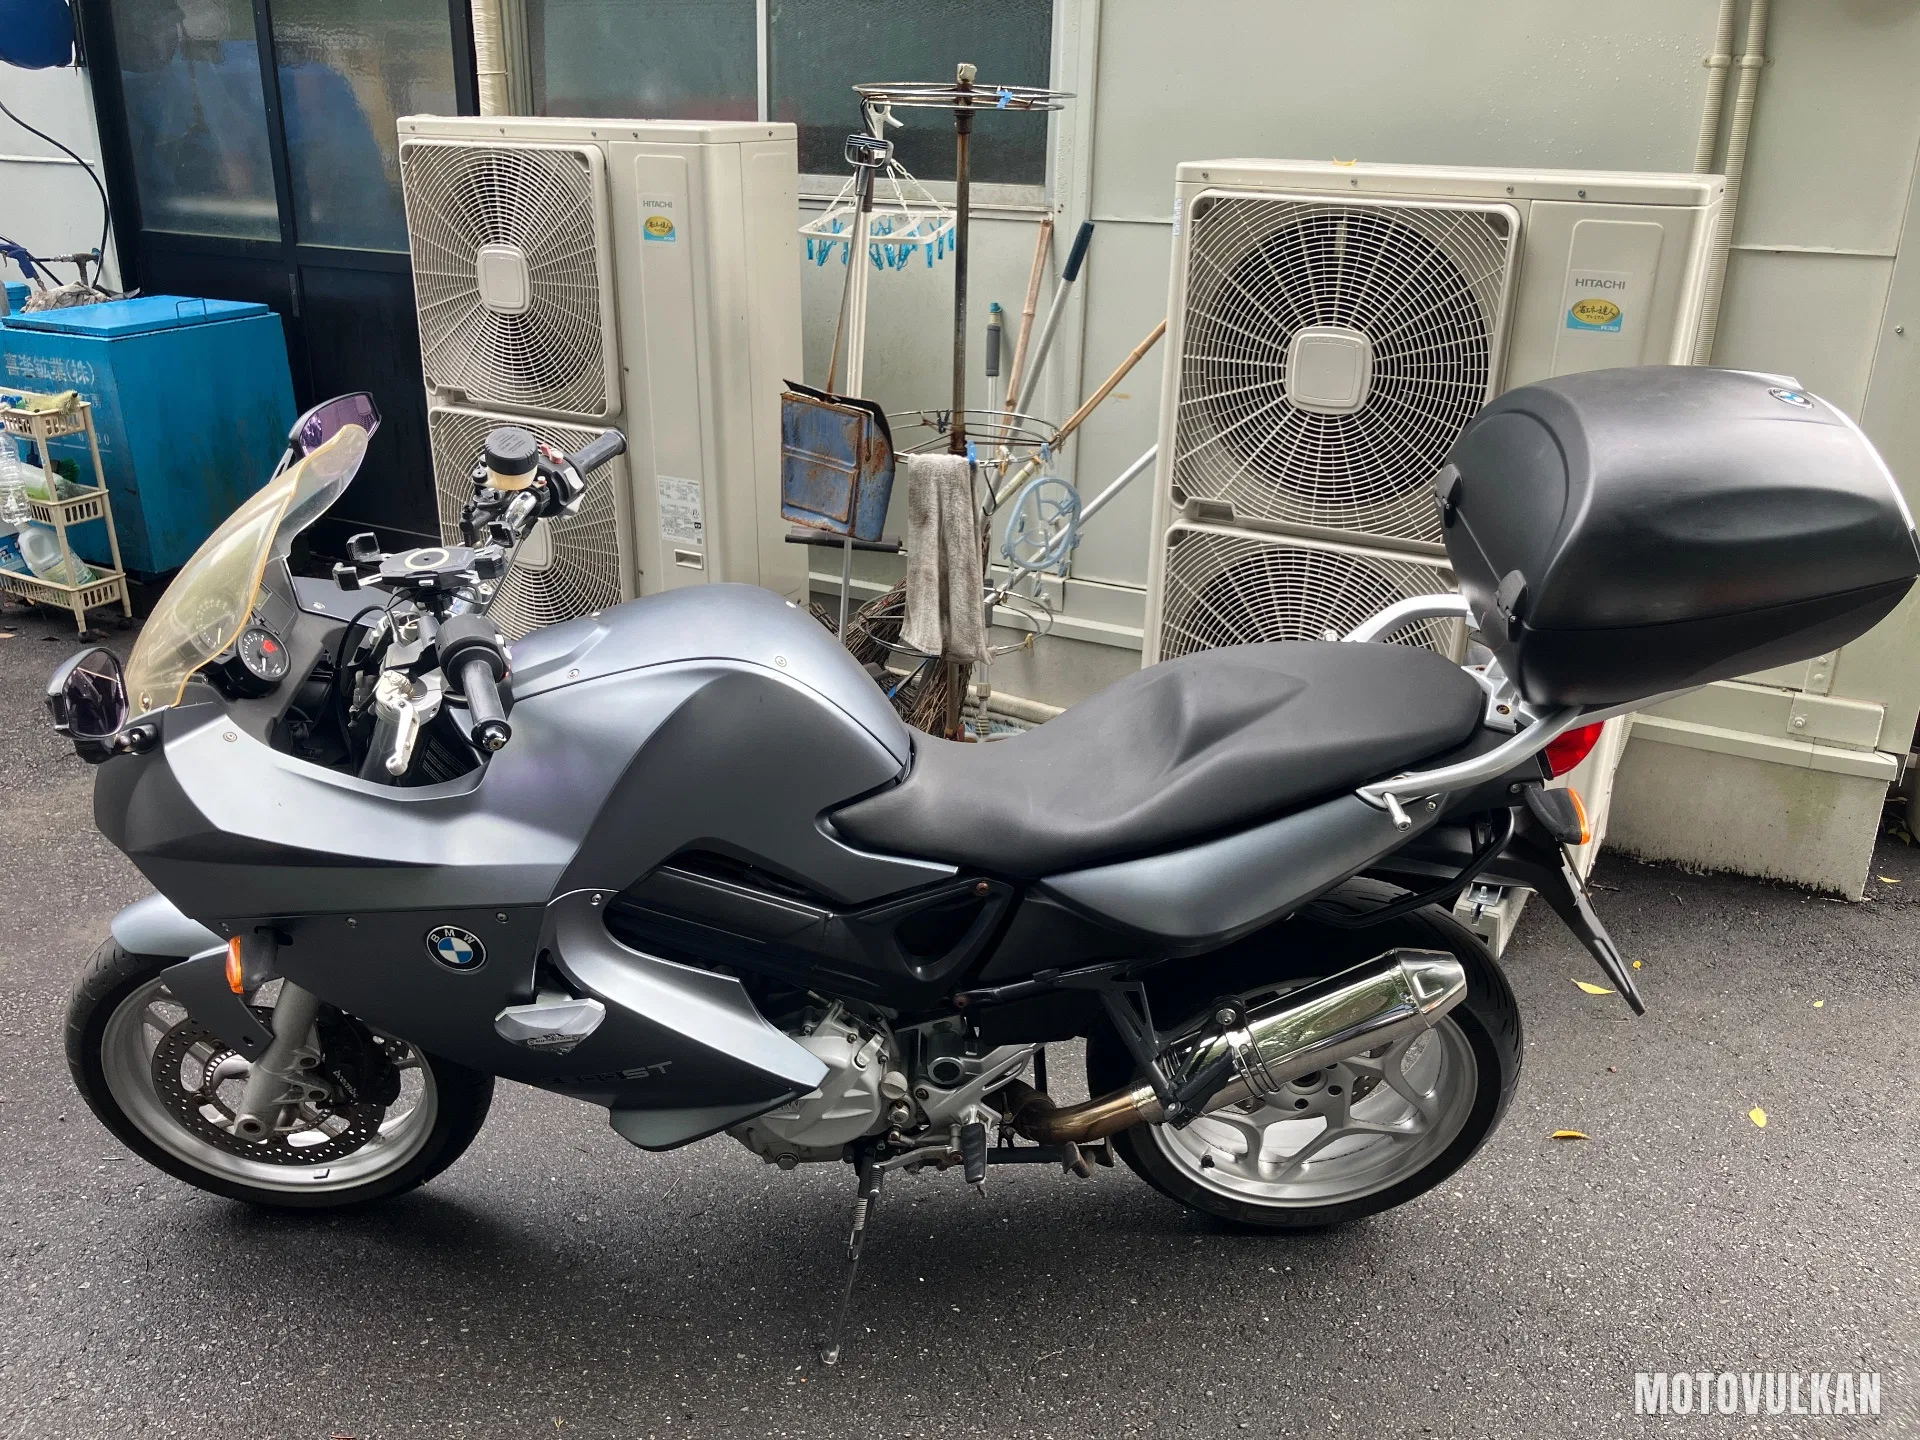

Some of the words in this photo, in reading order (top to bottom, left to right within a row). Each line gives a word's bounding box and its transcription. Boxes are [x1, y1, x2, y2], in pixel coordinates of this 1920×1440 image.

[643, 200, 673, 208] HITACHI
[1575, 278, 1626, 290] HITACHI
[430, 928, 476, 944] BMW
